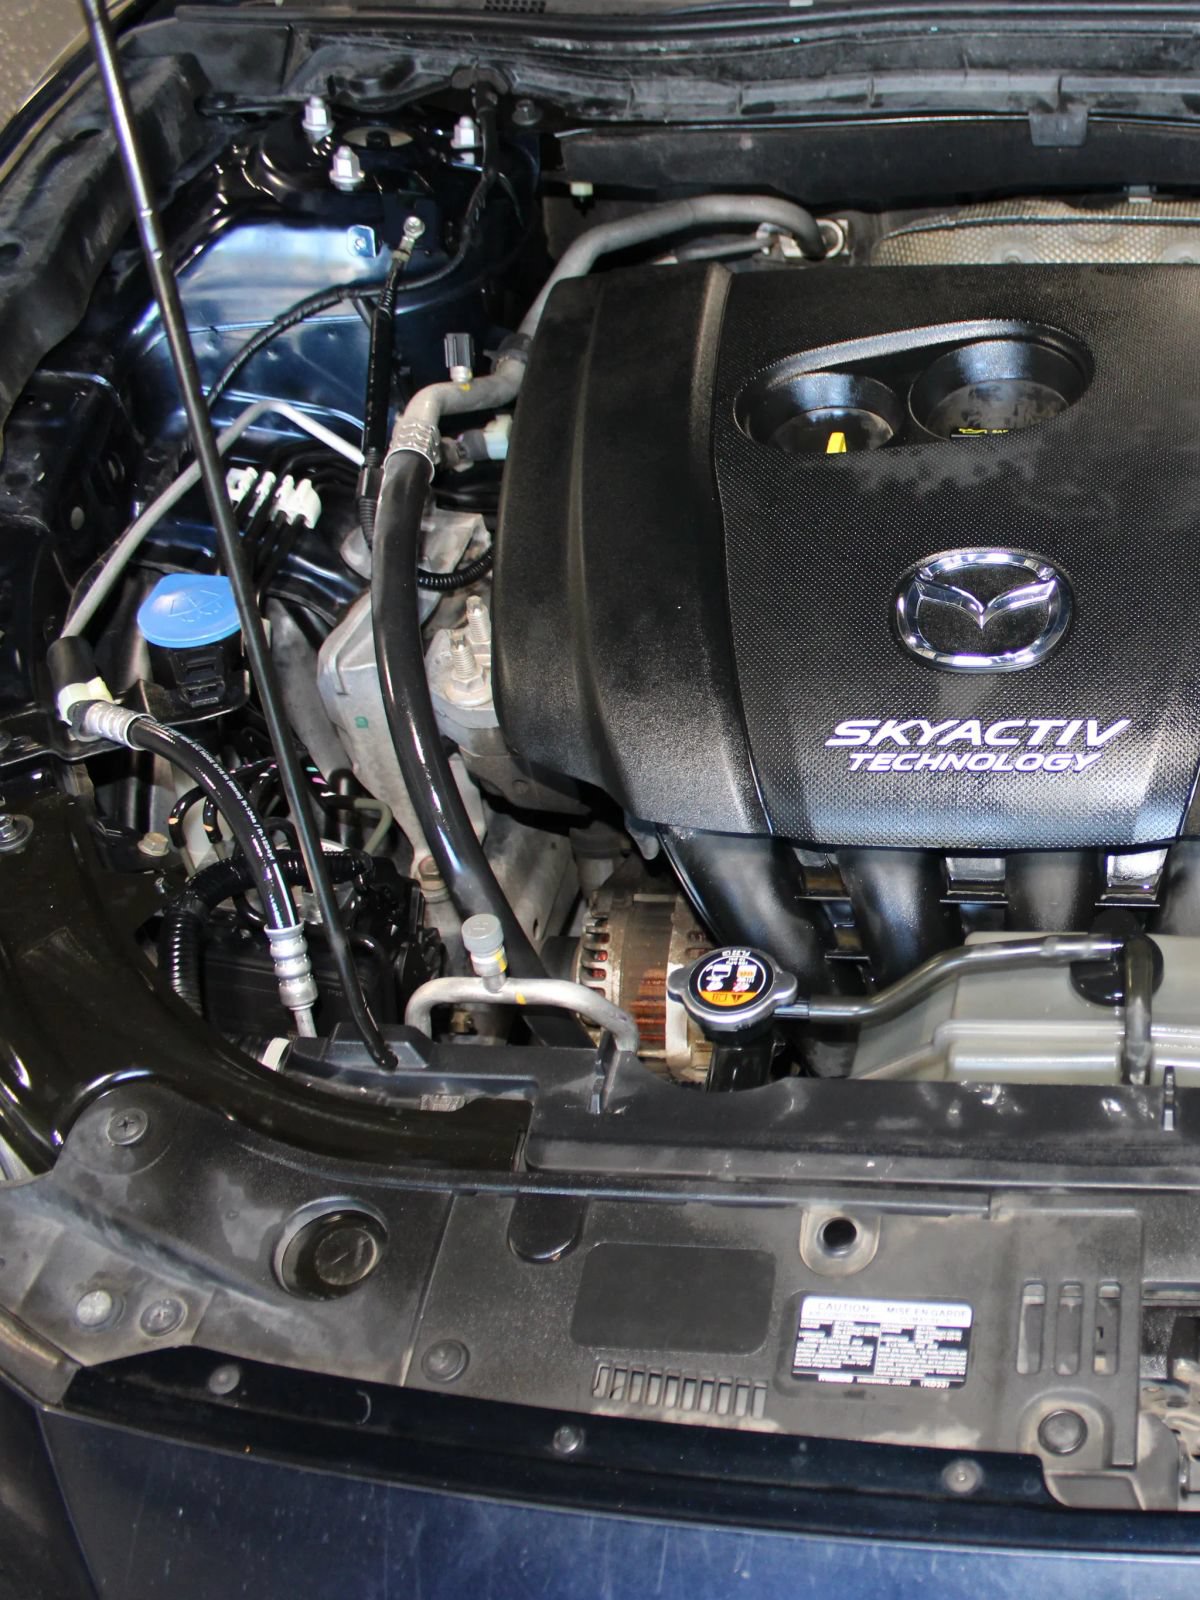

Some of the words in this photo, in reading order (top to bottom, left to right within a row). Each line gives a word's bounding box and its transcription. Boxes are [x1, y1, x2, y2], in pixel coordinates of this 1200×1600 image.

[825, 719, 1132, 747] SKYACTIV
[849, 753, 1103, 772] TECHNOLOGY
[200, 750, 215, 763] HOSE
[241, 799, 257, 824] R-134a
[257, 827, 276, 861] R-1234yf
[818, 1302, 870, 1312] CAUTION
[886, 1306, 911, 1315] MISE
[914, 1308, 929, 1316] EN
[931, 1309, 967, 1318] GARDE
